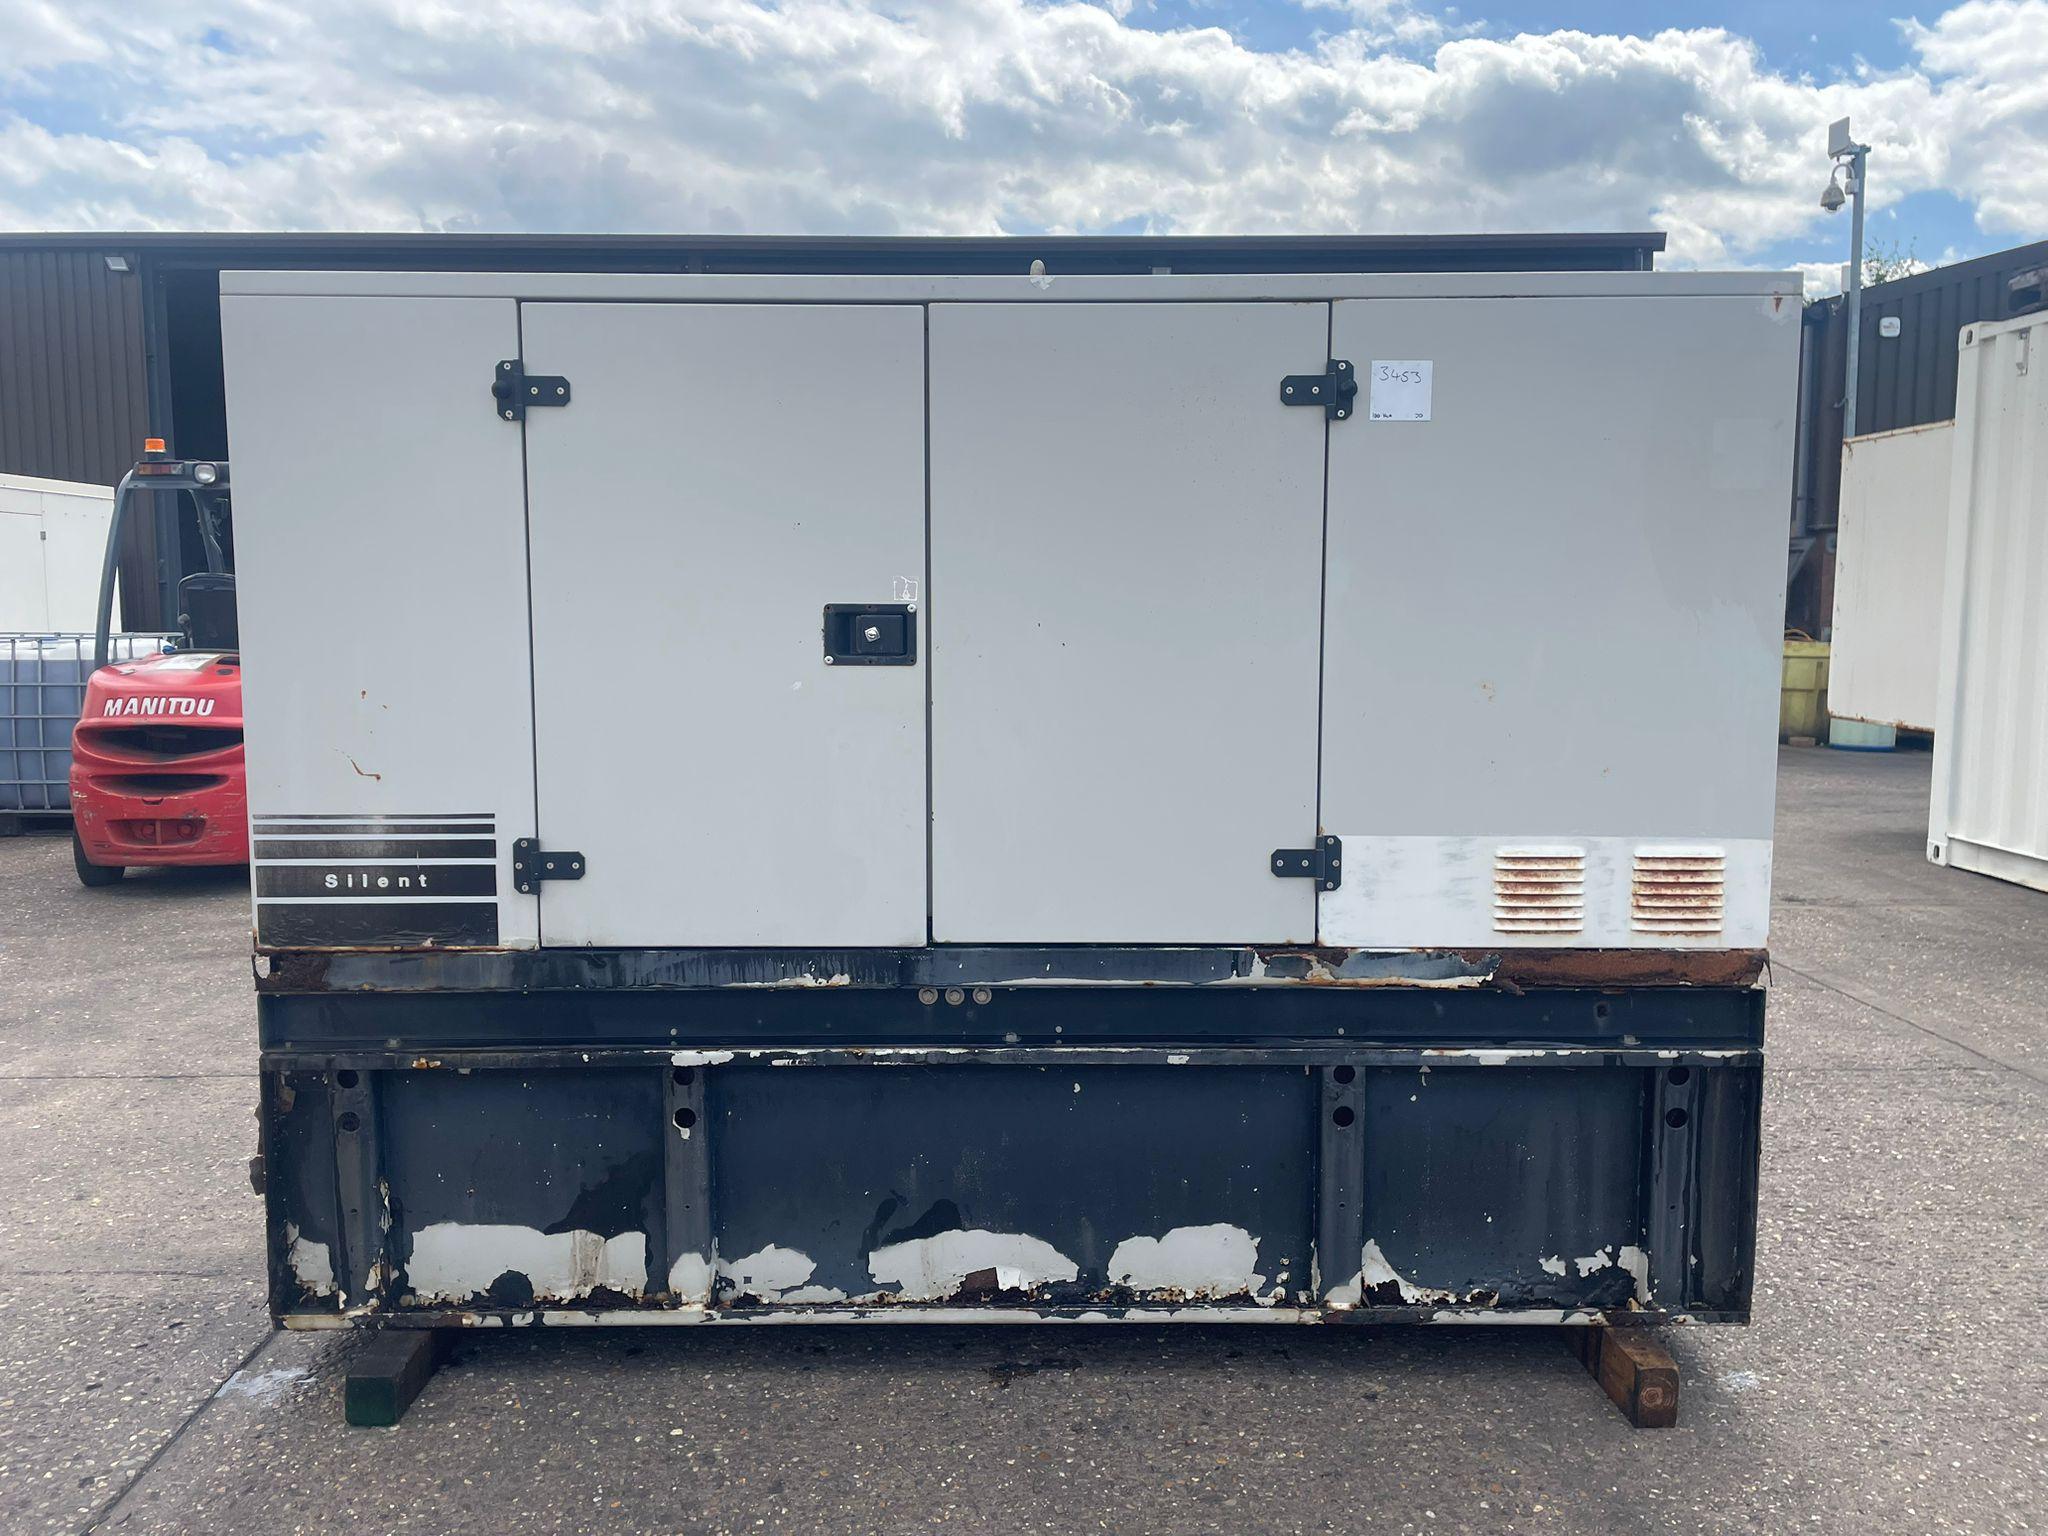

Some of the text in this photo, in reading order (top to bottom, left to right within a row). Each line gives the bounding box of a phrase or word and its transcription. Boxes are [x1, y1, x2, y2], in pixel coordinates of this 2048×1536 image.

[1379, 365, 1422, 384] 3453
[103, 697, 215, 717] MANITOU
[324, 873, 428, 888] Silent
